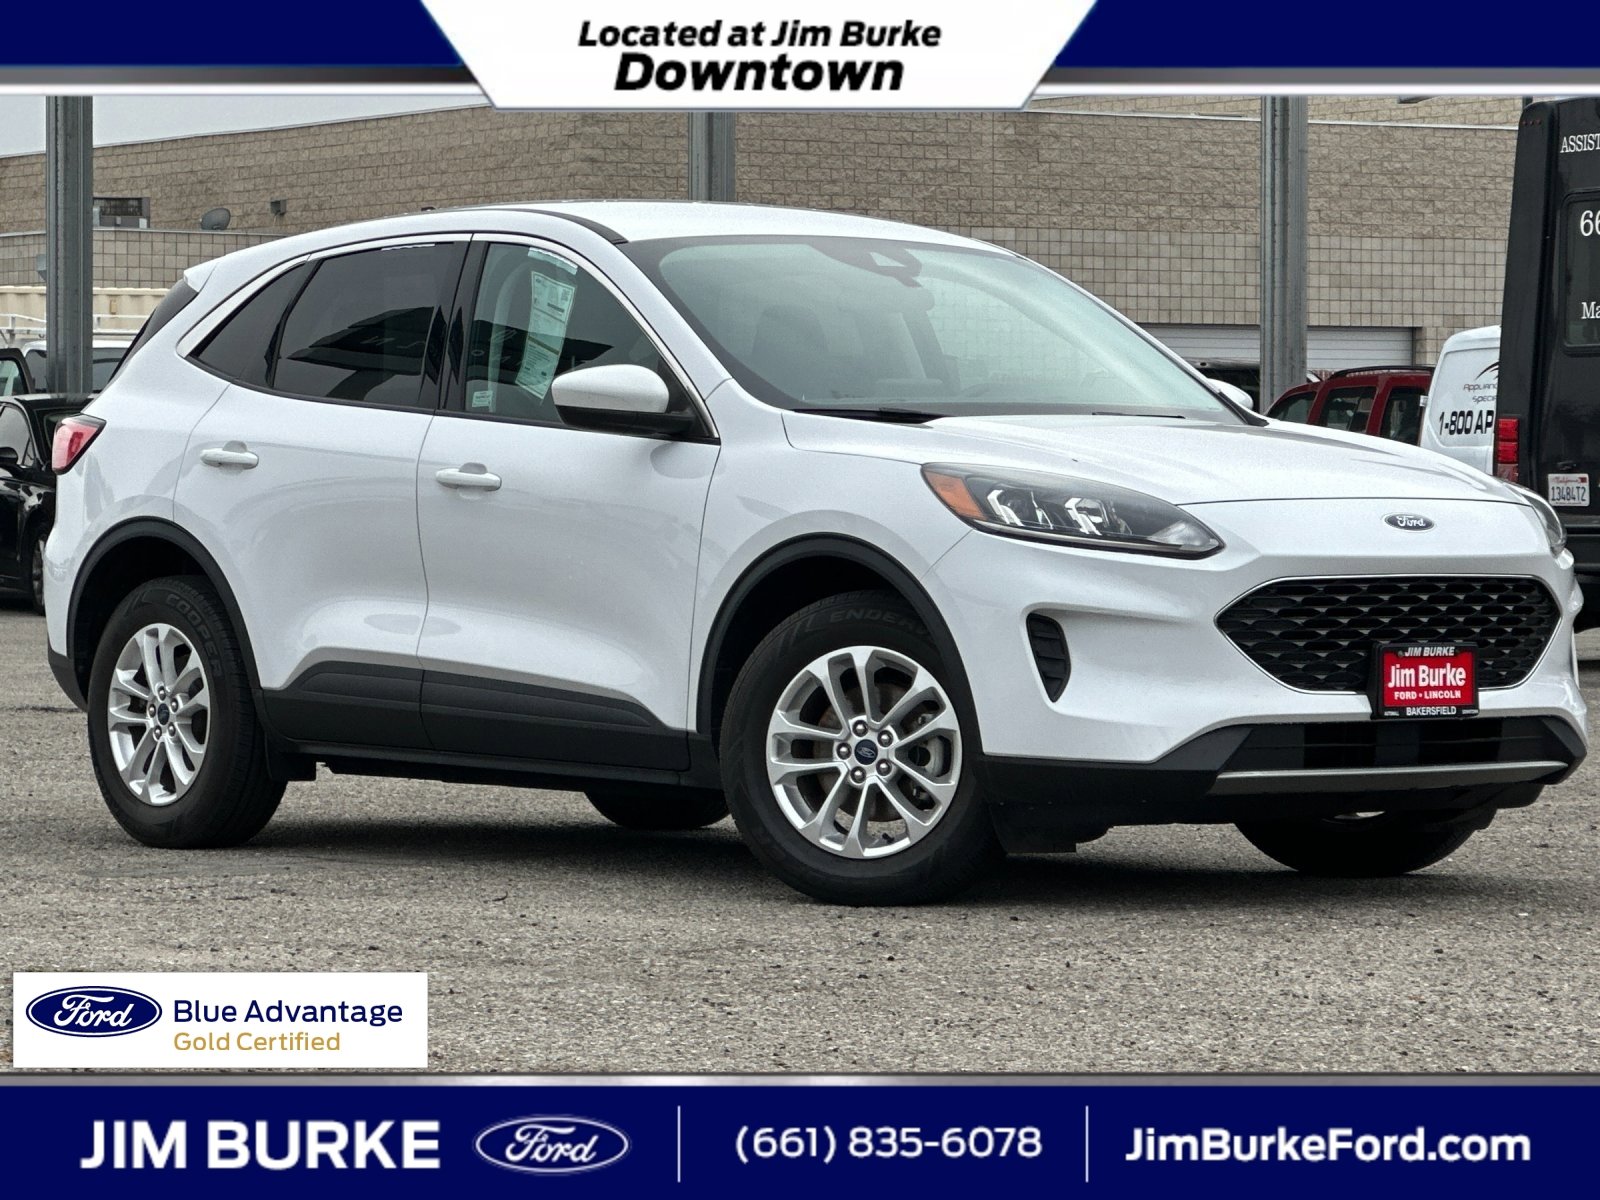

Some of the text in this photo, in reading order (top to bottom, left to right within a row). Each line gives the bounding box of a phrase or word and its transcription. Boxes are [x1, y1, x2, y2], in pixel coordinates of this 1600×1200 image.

[1560, 133, 1600, 153] ASSIST
[1439, 410, 1474, 435] 1-800
[1396, 515, 1426, 527] Ford
[1404, 646, 1455, 657] JIM BURKE
[1388, 662, 1467, 688] Jim Burke
[1394, 690, 1461, 700] FORD LINCOLN
[1406, 706, 1457, 716] BAKERSFIELD
